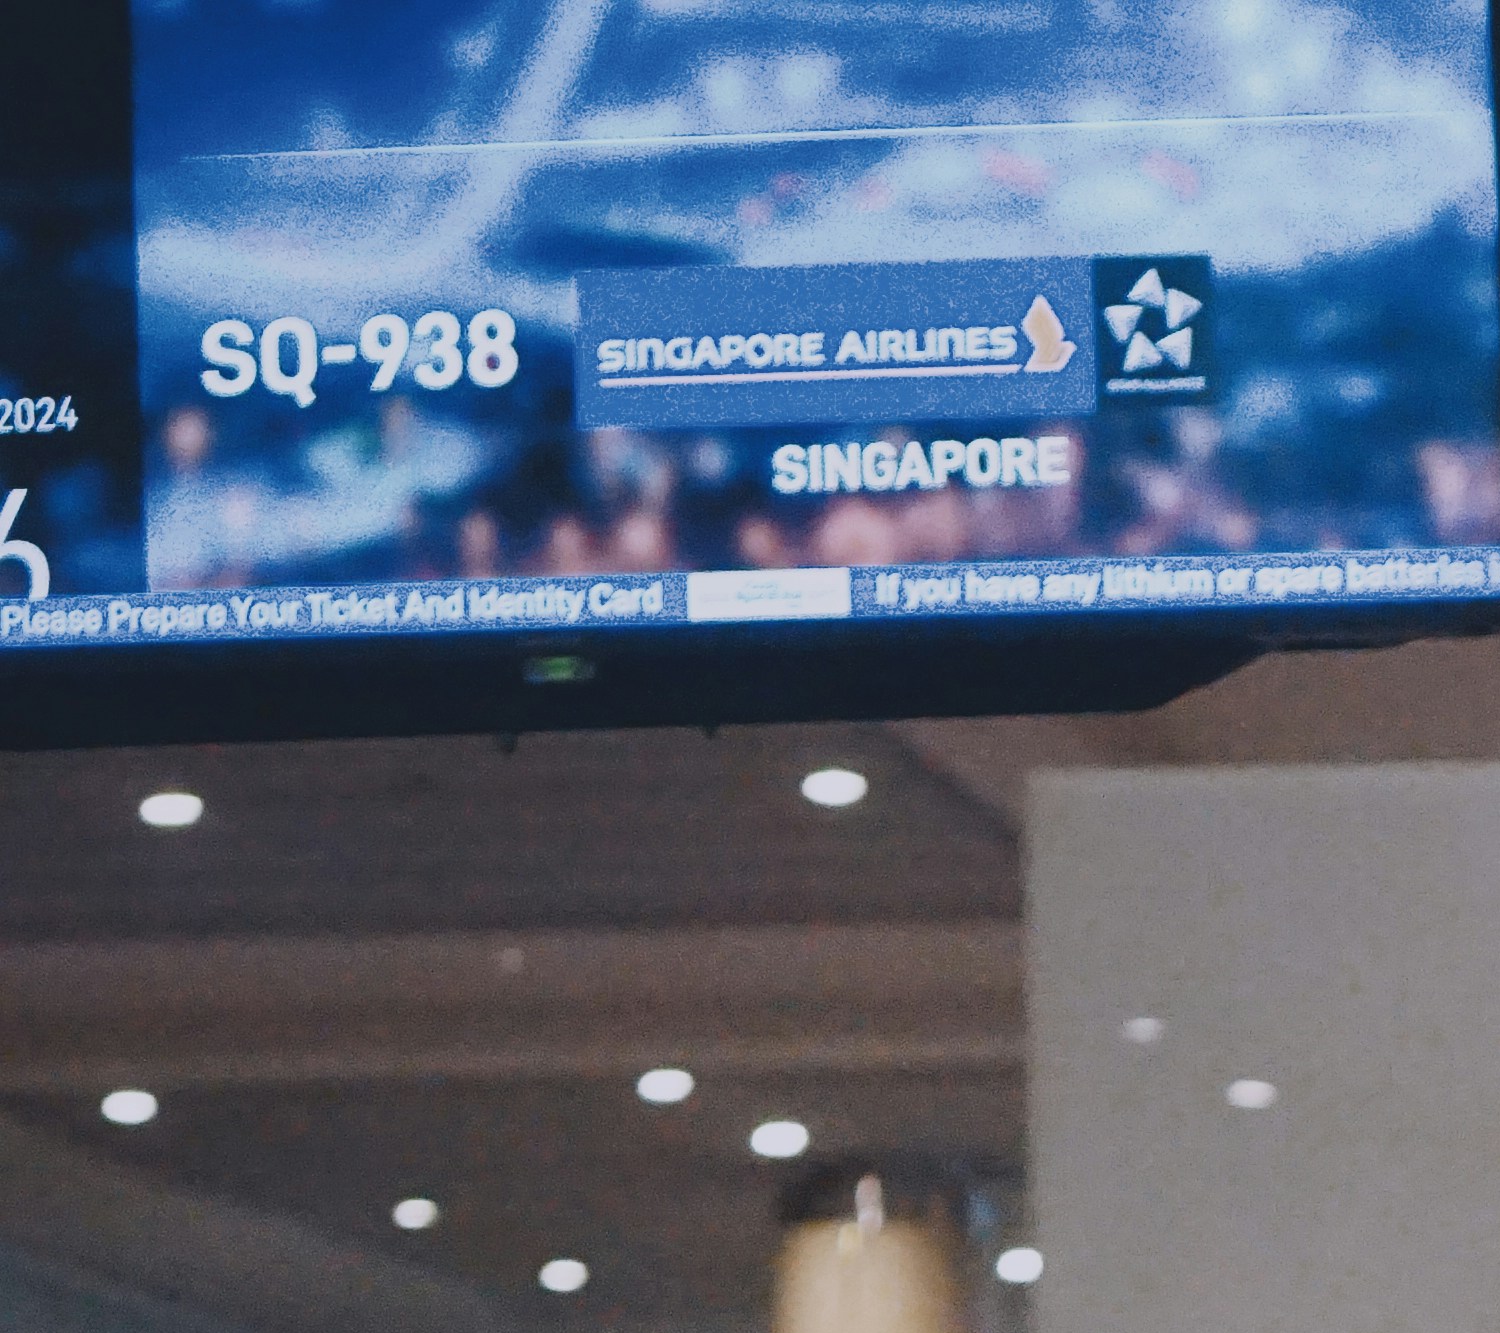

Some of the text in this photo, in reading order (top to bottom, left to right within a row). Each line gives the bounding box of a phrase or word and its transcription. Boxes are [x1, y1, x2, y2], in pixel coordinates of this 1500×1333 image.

[200, 310, 520, 408] SQ-938
[598, 325, 1018, 374] SINGAPORE AIRLINES
[0, 395, 79, 434] 2024
[771, 435, 1071, 495] SINGAPORE
[1, 581, 664, 636] Please Prepare Your Ticket And Identity Card
[876, 572, 902, 602] If
[903, 576, 962, 610] you
[965, 570, 1039, 602] have
[1042, 571, 1100, 607] any
[1101, 563, 1215, 599] lithium
[1218, 567, 1252, 595] or
[1253, 564, 1344, 598] spare
[1346, 554, 1486, 594] batteries
